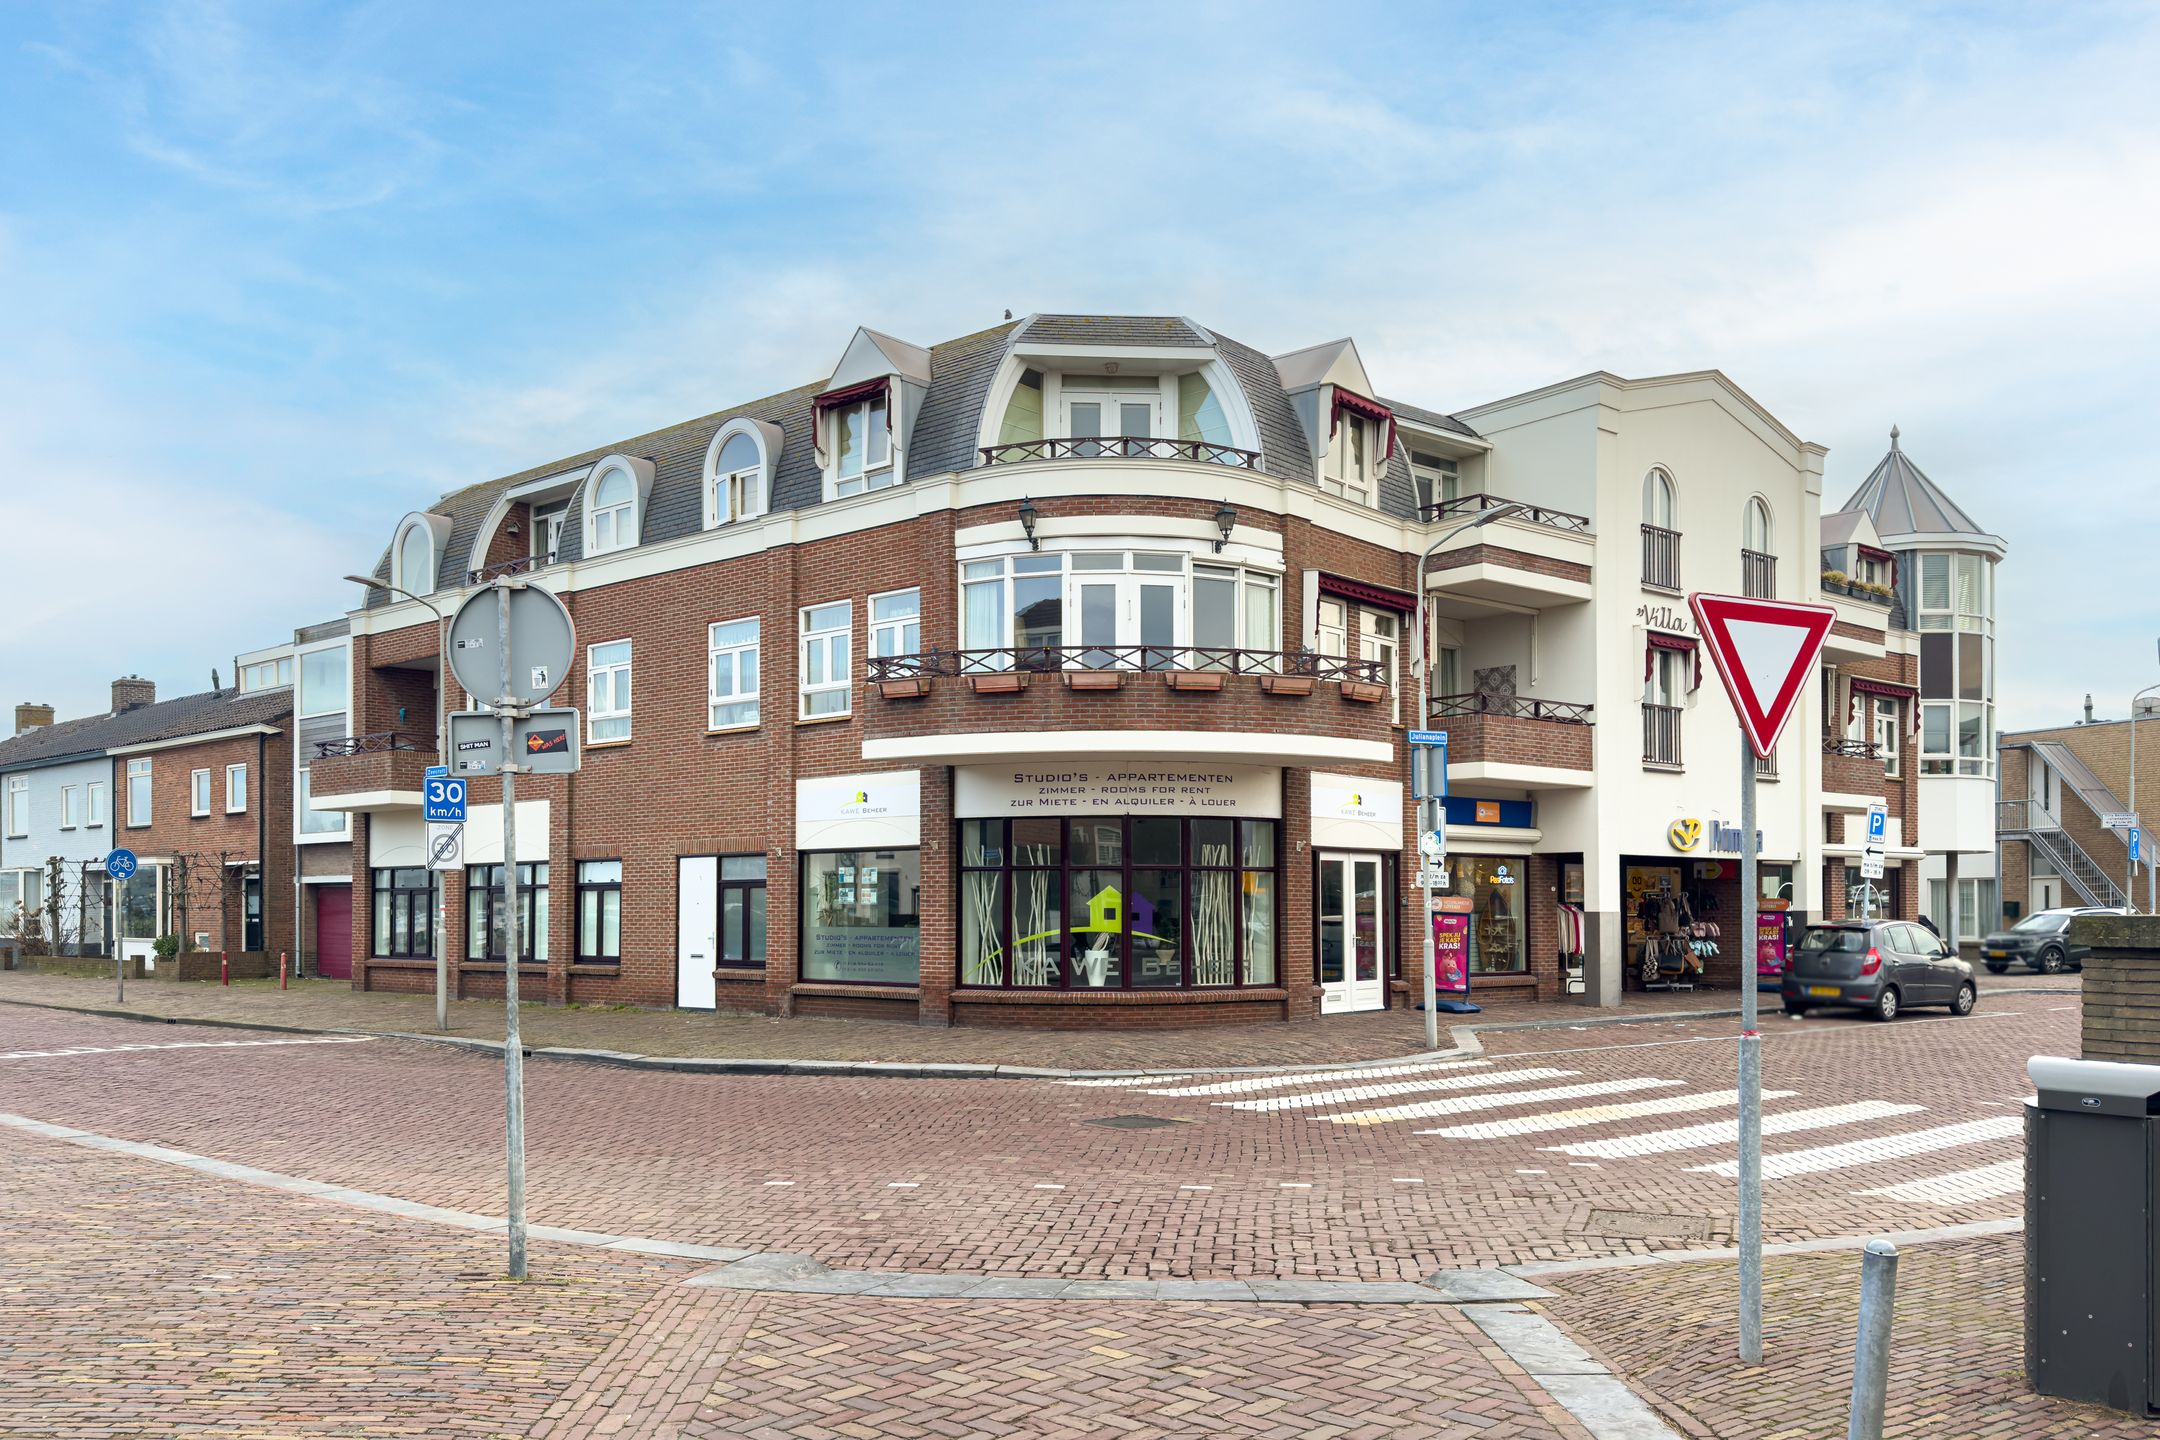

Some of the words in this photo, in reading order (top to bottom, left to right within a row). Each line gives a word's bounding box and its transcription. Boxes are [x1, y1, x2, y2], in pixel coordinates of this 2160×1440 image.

[1411, 732, 1446, 742] Julianaplein
[460, 742, 473, 750] SHIT
[1107, 773, 1233, 783] APPARTEMENTEN
[429, 782, 462, 803] 30
[1114, 798, 1175, 806] ALQUILER
[1189, 796, 1196, 806] À
[430, 806, 462, 817] km/h
[1873, 815, 1881, 832] P
[2133, 832, 2138, 847] P
